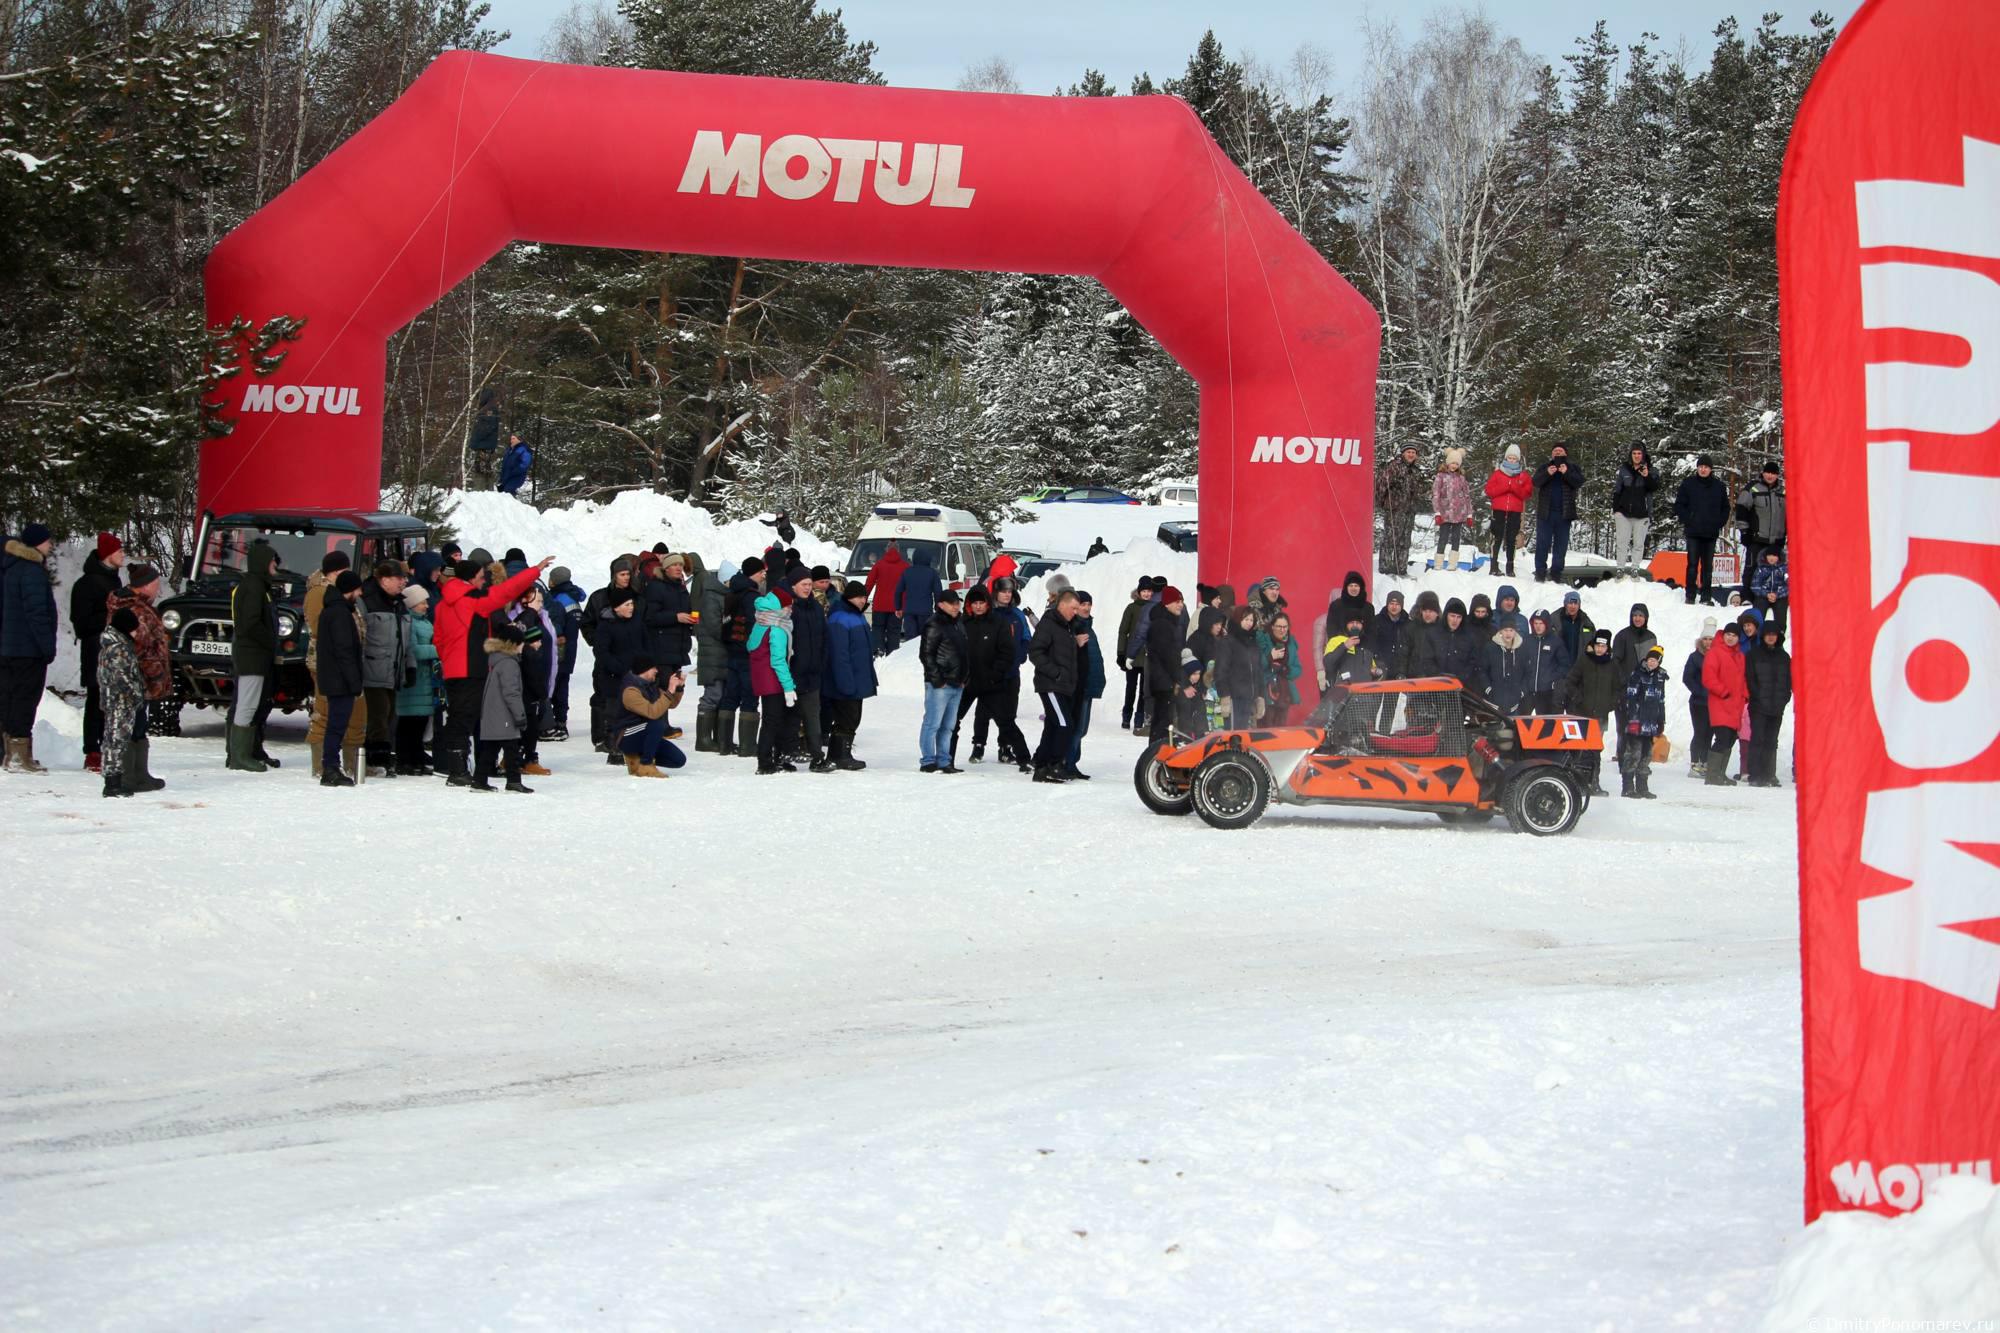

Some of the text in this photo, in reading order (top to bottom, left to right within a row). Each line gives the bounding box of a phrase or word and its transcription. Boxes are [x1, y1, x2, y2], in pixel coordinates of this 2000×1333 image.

[677, 130, 976, 208] MOTUL
[240, 384, 362, 415] MOTUL
[1249, 436, 1363, 465] MOTUL
[1855, 135, 2000, 1011] MOTUL
